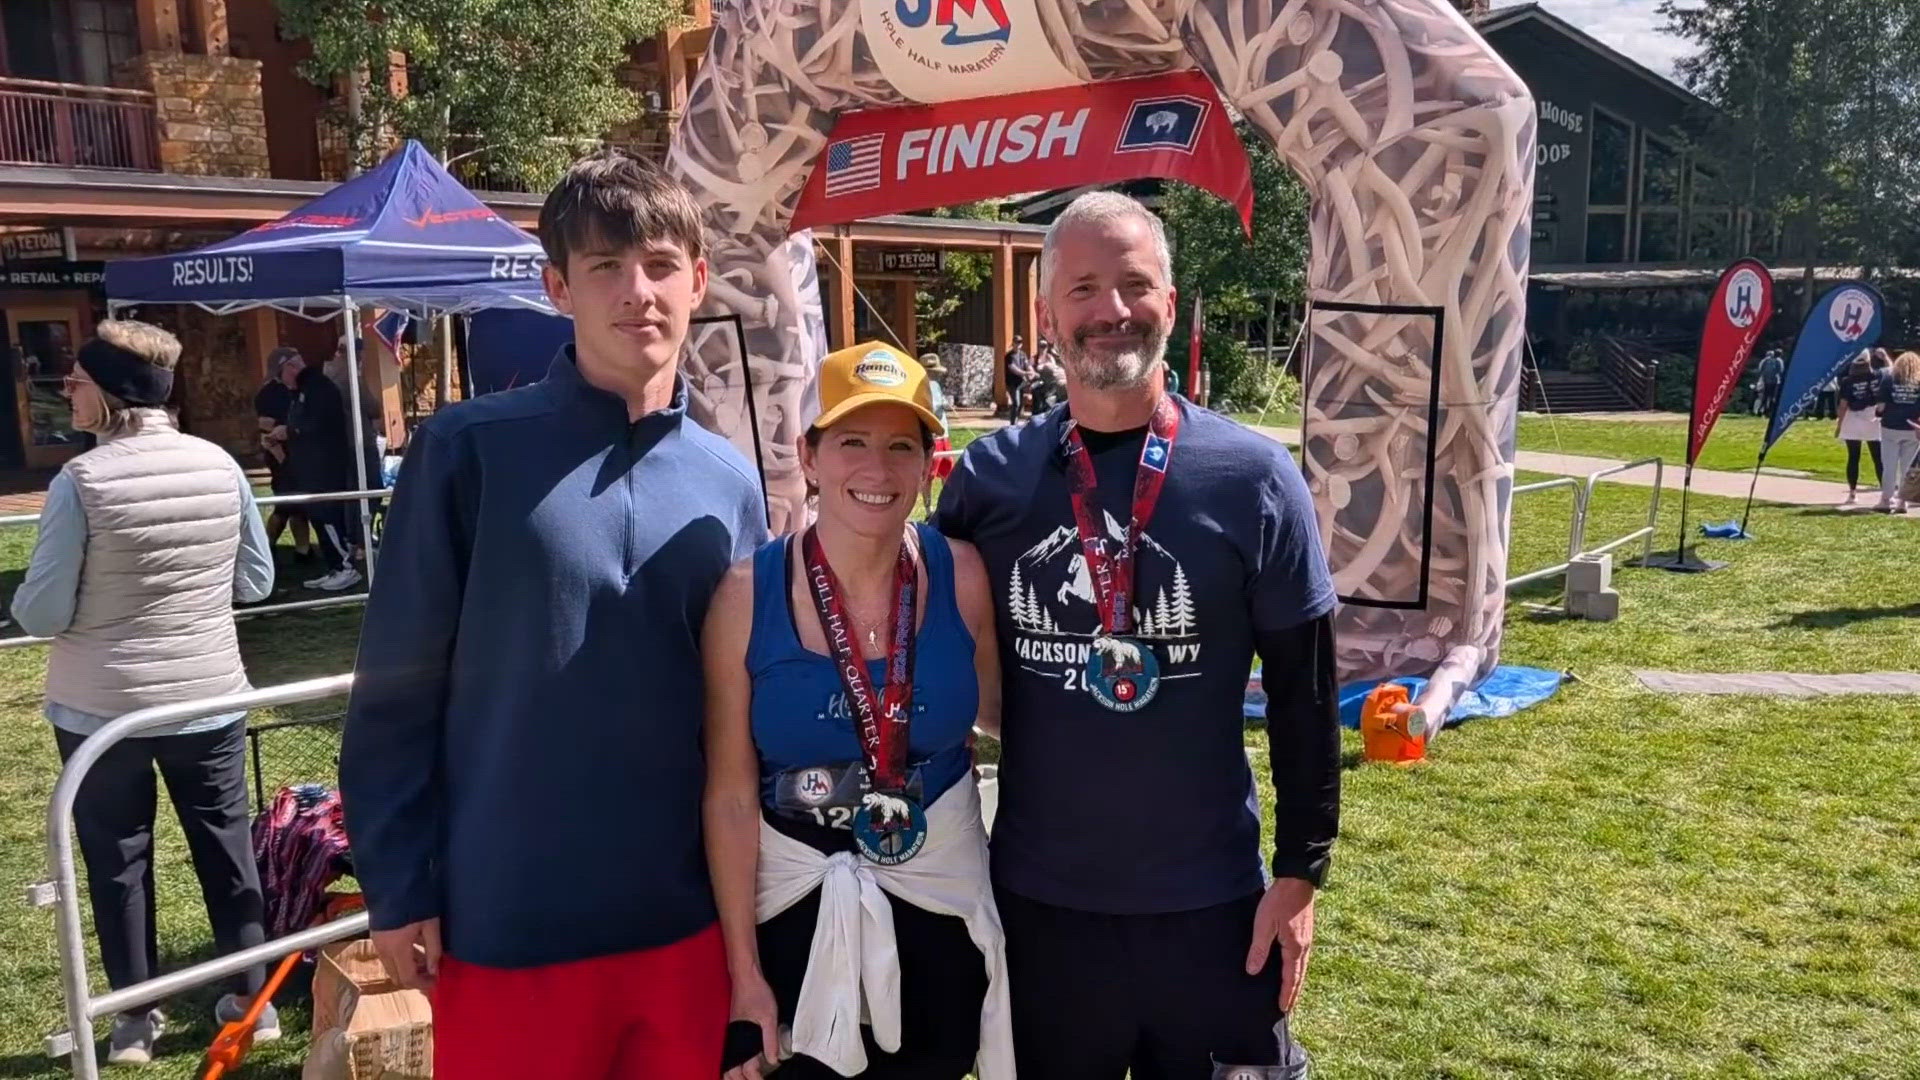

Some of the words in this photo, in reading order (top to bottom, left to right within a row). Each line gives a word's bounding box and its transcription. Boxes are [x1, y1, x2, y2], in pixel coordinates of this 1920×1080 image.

[880, 11, 904, 49] HOLE
[908, 49, 942, 71] HALF
[948, 43, 1006, 74] MARATHON
[1539, 100, 1583, 133] MOOSE
[897, 108, 1092, 181] FINISH
[17, 231, 61, 250] TETON
[898, 252, 936, 263] TETON
[10, 272, 60, 284] RETAIL
[172, 256, 254, 287] RESULTS!
[811, 564, 834, 613] FULL,
[828, 614, 852, 664] HALF,
[846, 664, 881, 748] QUARTER
[1167, 643, 1201, 664] WY
[1115, 702, 1134, 712] HOLE
[880, 855, 898, 865] HOLE
